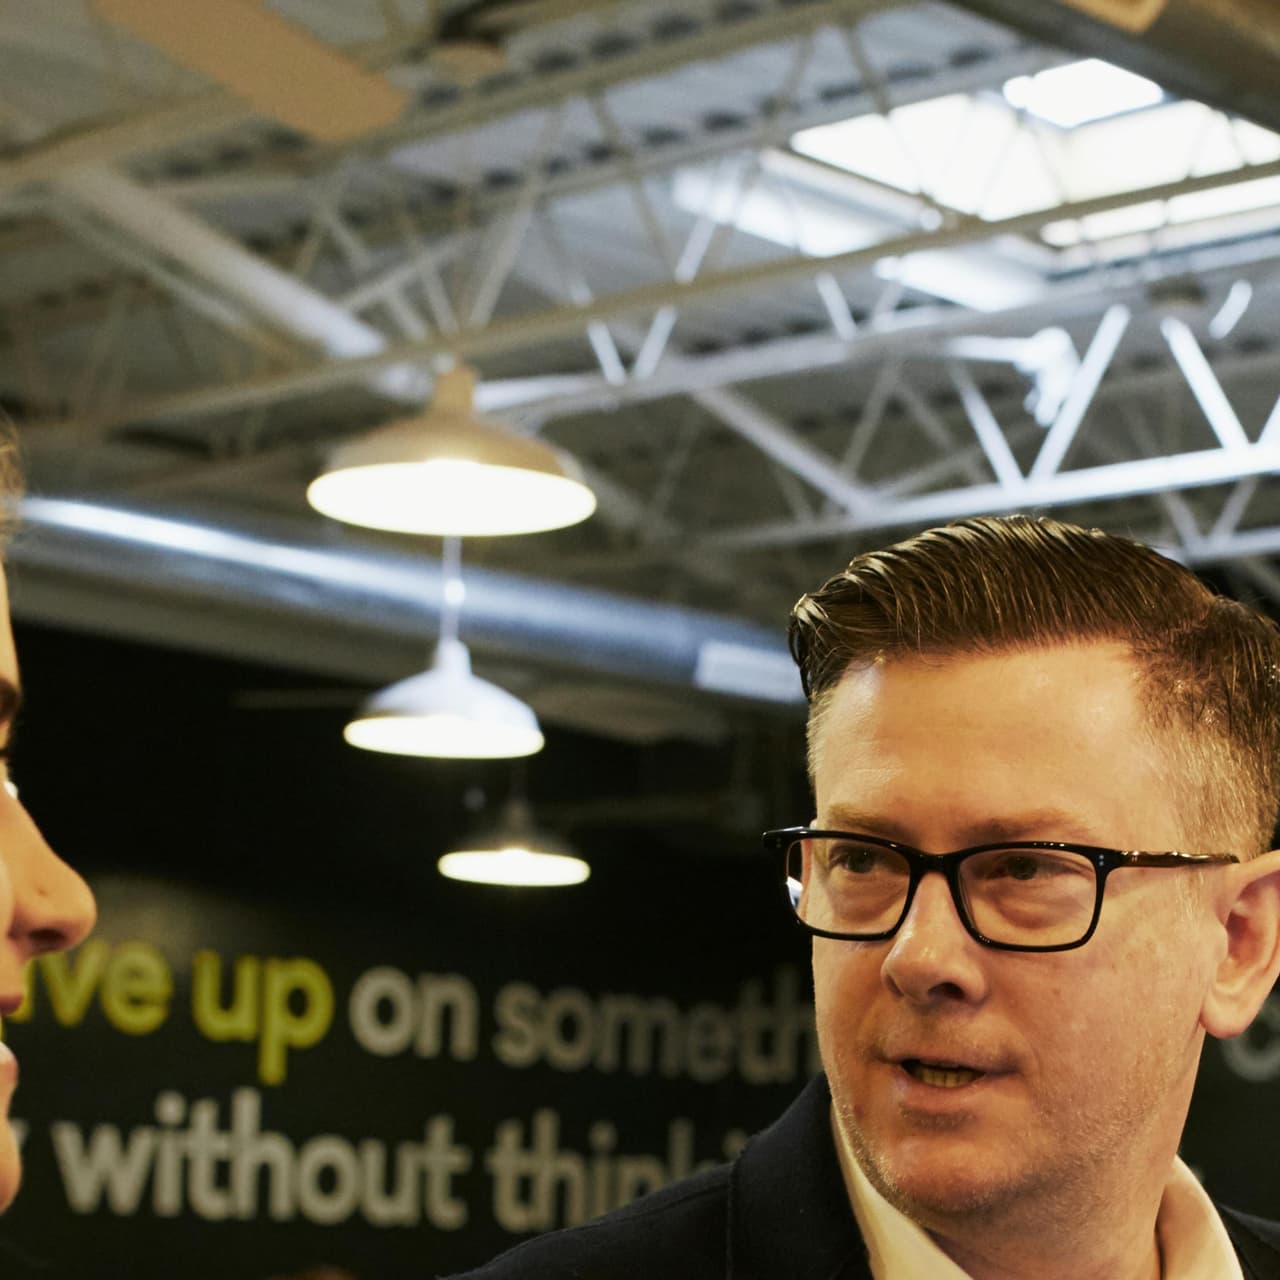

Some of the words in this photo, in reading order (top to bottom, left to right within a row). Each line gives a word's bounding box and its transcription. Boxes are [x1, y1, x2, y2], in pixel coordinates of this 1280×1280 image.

[191, 947, 335, 1087] up
[348, 965, 480, 1061] on
[493, 963, 822, 1085] someth
[50, 1086, 472, 1232] without
